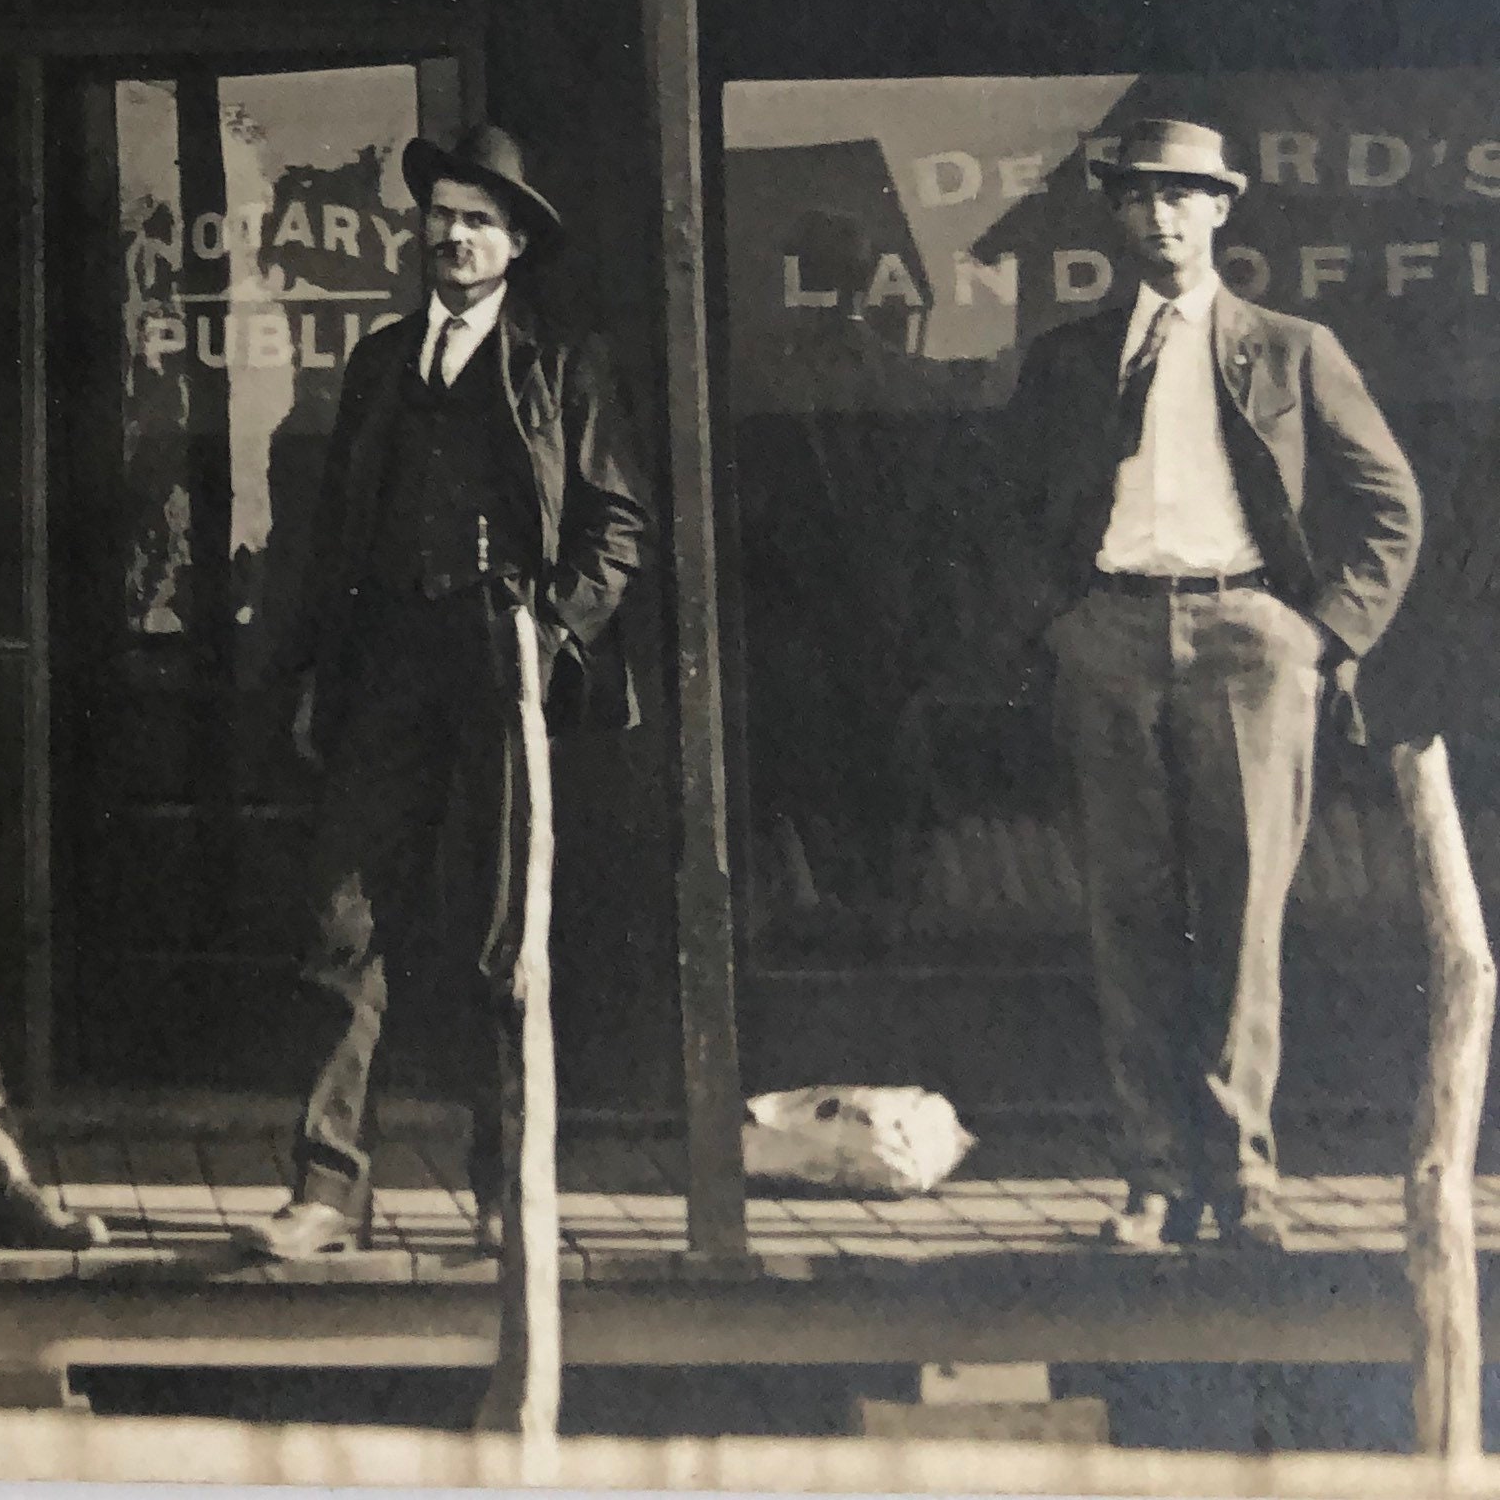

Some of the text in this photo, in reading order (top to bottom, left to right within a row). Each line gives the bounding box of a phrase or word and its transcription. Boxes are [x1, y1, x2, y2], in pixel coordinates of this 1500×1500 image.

[912, 131, 1500, 208] DEFRD'S
[142, 200, 414, 290] NOTARY
[783, 240, 1490, 308] LAND OFFI
[143, 312, 403, 377] PUBLI
